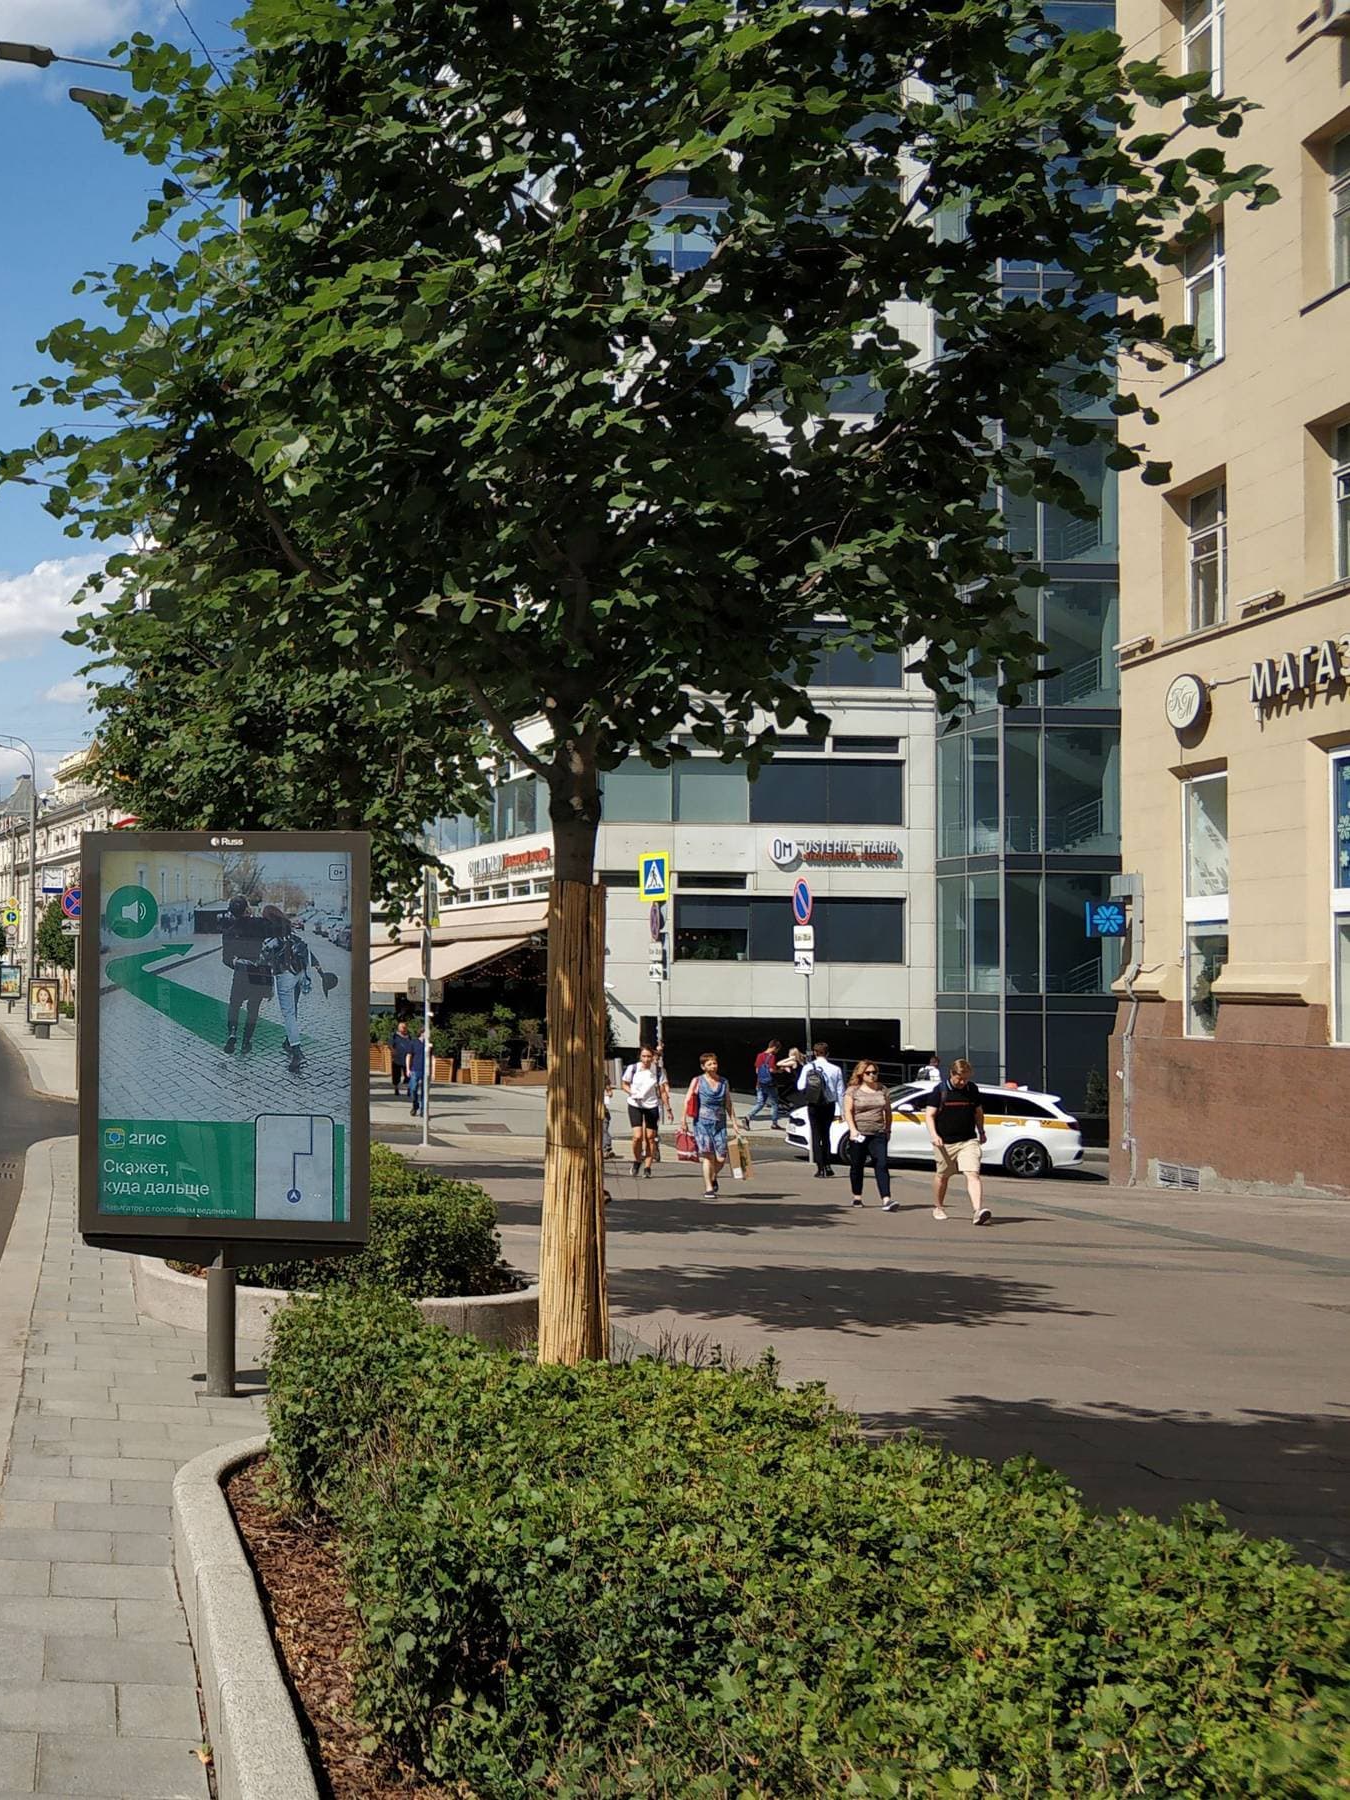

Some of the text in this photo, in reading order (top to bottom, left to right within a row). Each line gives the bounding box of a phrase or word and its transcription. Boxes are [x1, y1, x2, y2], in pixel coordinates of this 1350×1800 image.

[221, 837, 244, 846] Russ
[803, 840, 899, 854] OSTERIA MARIO
[128, 1133, 167, 1146] 2ГИС
[103, 1158, 169, 1177] Скажет,
[103, 1180, 210, 1197] куда дальше
[197, 1207, 237, 1216] ведением
